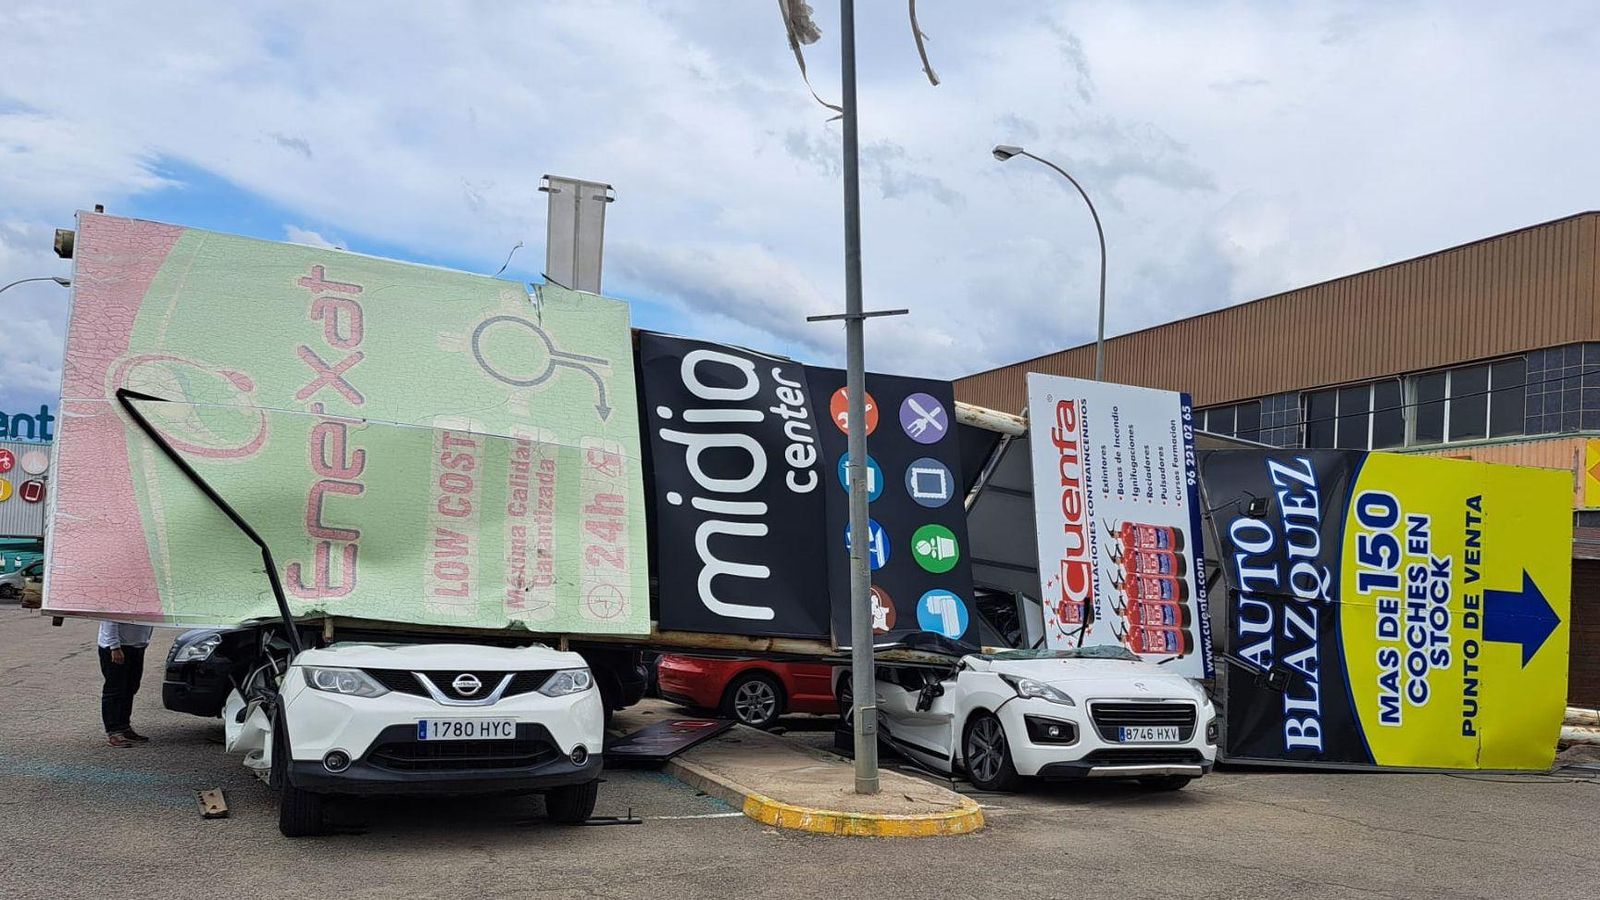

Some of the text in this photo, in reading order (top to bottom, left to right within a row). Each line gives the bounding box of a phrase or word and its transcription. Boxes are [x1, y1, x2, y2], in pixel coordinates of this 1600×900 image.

[657, 349, 775, 621] midia
[769, 367, 818, 493] center
[1101, 445, 1109, 493] Extintores
[1112, 405, 1124, 495] Bocas de Incendio
[1128, 424, 1140, 496] Ignifugaciones
[1144, 445, 1153, 498] Rociadores
[1158, 446, 1168, 500] Pulsadores
[1174, 470, 1182, 501] Cursos
[1182, 405, 1196, 486] 96 221 02 65
[434, 431, 478, 598] LOW COST
[533, 459, 555, 588] Garantizada
[584, 491, 625, 571] 24h
[1051, 398, 1091, 602] Cuenfa
[1081, 398, 1102, 621] INSTALACIONES CONTRAINCENDIOS
[1197, 557, 1214, 673] www.cuenfa.com
[1231, 518, 1280, 669] AUTO
[1270, 457, 1330, 751] BLAZQUEZ
[1357, 493, 1401, 723] MAS DE 150
[1405, 516, 1430, 705] COCHES EN
[1431, 557, 1451, 668] STOCK
[1462, 495, 1481, 737] PUNTO DE VENTA
[433, 721, 512, 738] 1780 HYC
[1126, 728, 1177, 740] 8746 HXV
